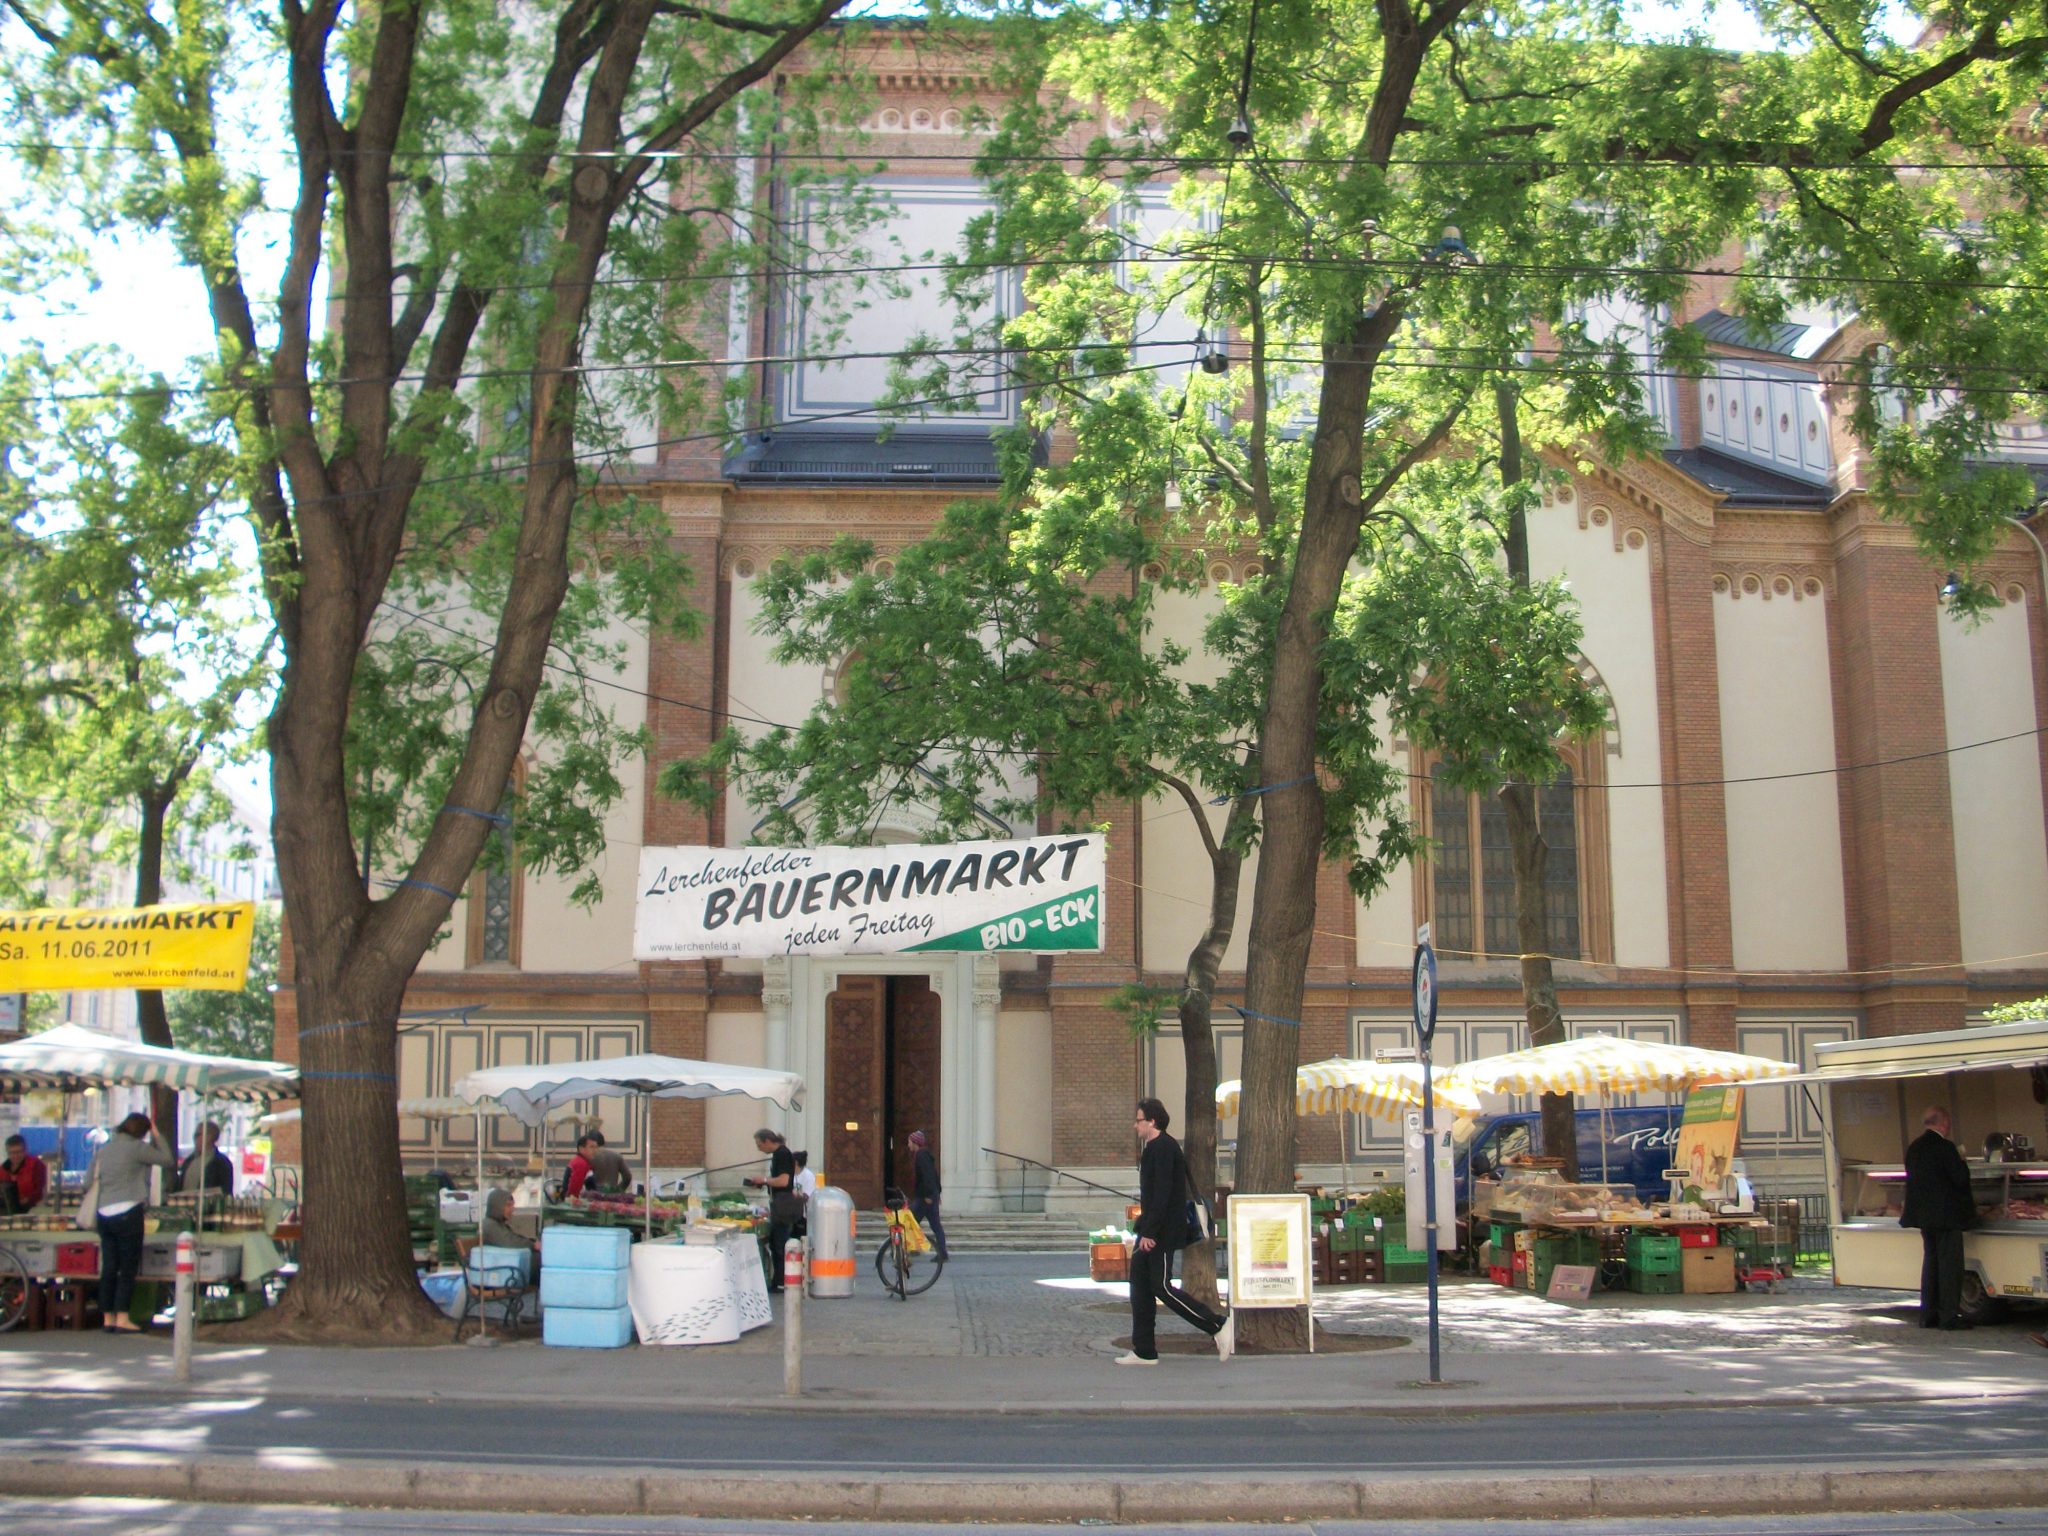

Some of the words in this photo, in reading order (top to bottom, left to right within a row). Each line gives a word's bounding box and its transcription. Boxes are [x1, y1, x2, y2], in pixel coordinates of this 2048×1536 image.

[645, 852, 813, 897] Lerchenfelder
[703, 838, 1090, 931] BAUERNMARKT
[784, 922, 840, 954] jeden
[848, 911, 935, 944] Freitag
[980, 894, 1095, 950] BIO-ECK
[0, 942, 30, 960] Sa.
[41, 939, 152, 959] 11.06.2011
[649, 941, 741, 952] www.lerchenfeld.at
[112, 967, 236, 979] www.lerchenfeld.at
